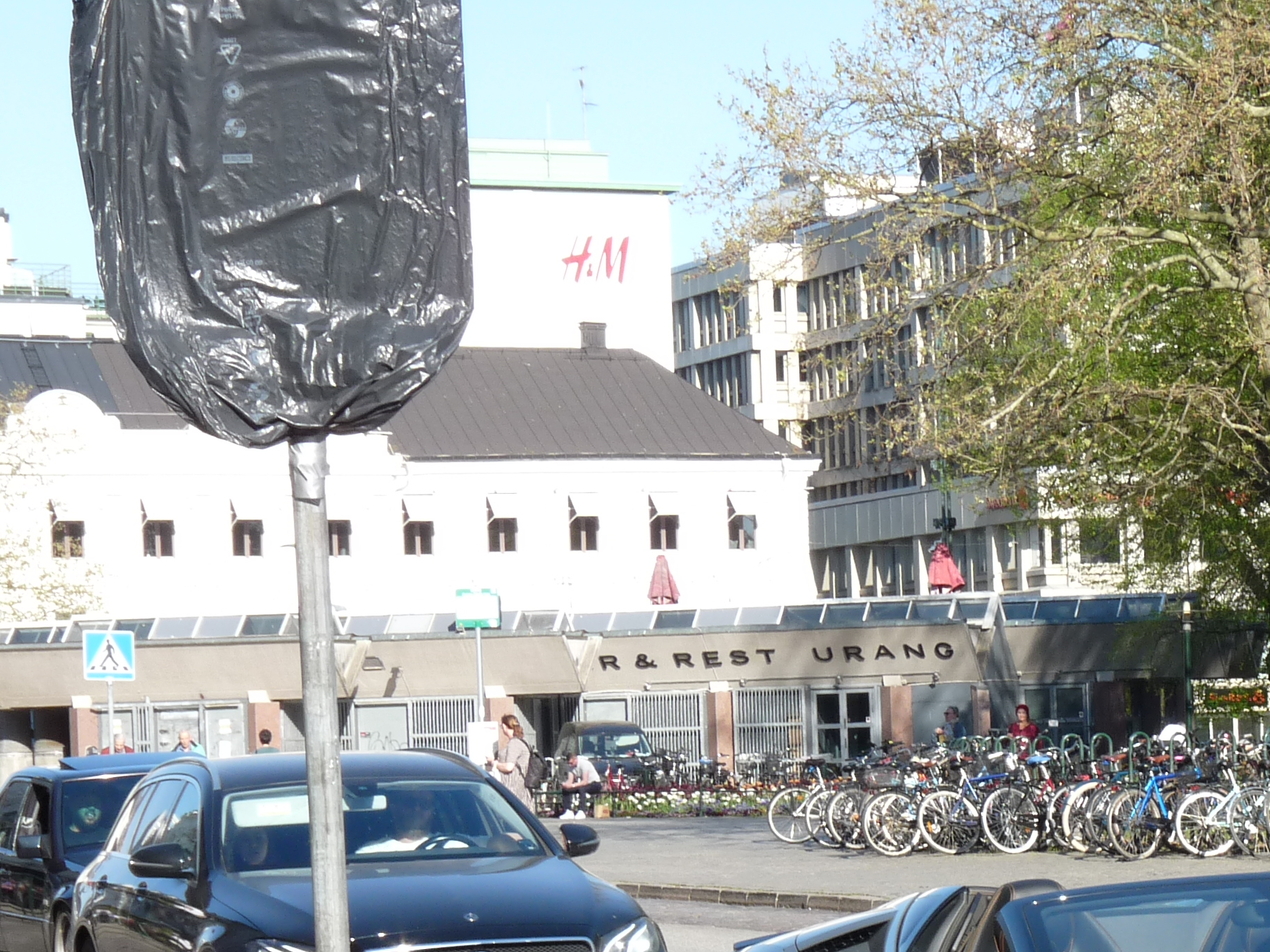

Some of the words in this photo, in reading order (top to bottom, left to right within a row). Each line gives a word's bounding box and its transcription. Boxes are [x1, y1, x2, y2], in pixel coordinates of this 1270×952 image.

[562, 235, 629, 284] H&M
[598, 655, 621, 671] R
[634, 653, 658, 670] &
[672, 648, 776, 670] REST
[812, 642, 954, 663] URANG
